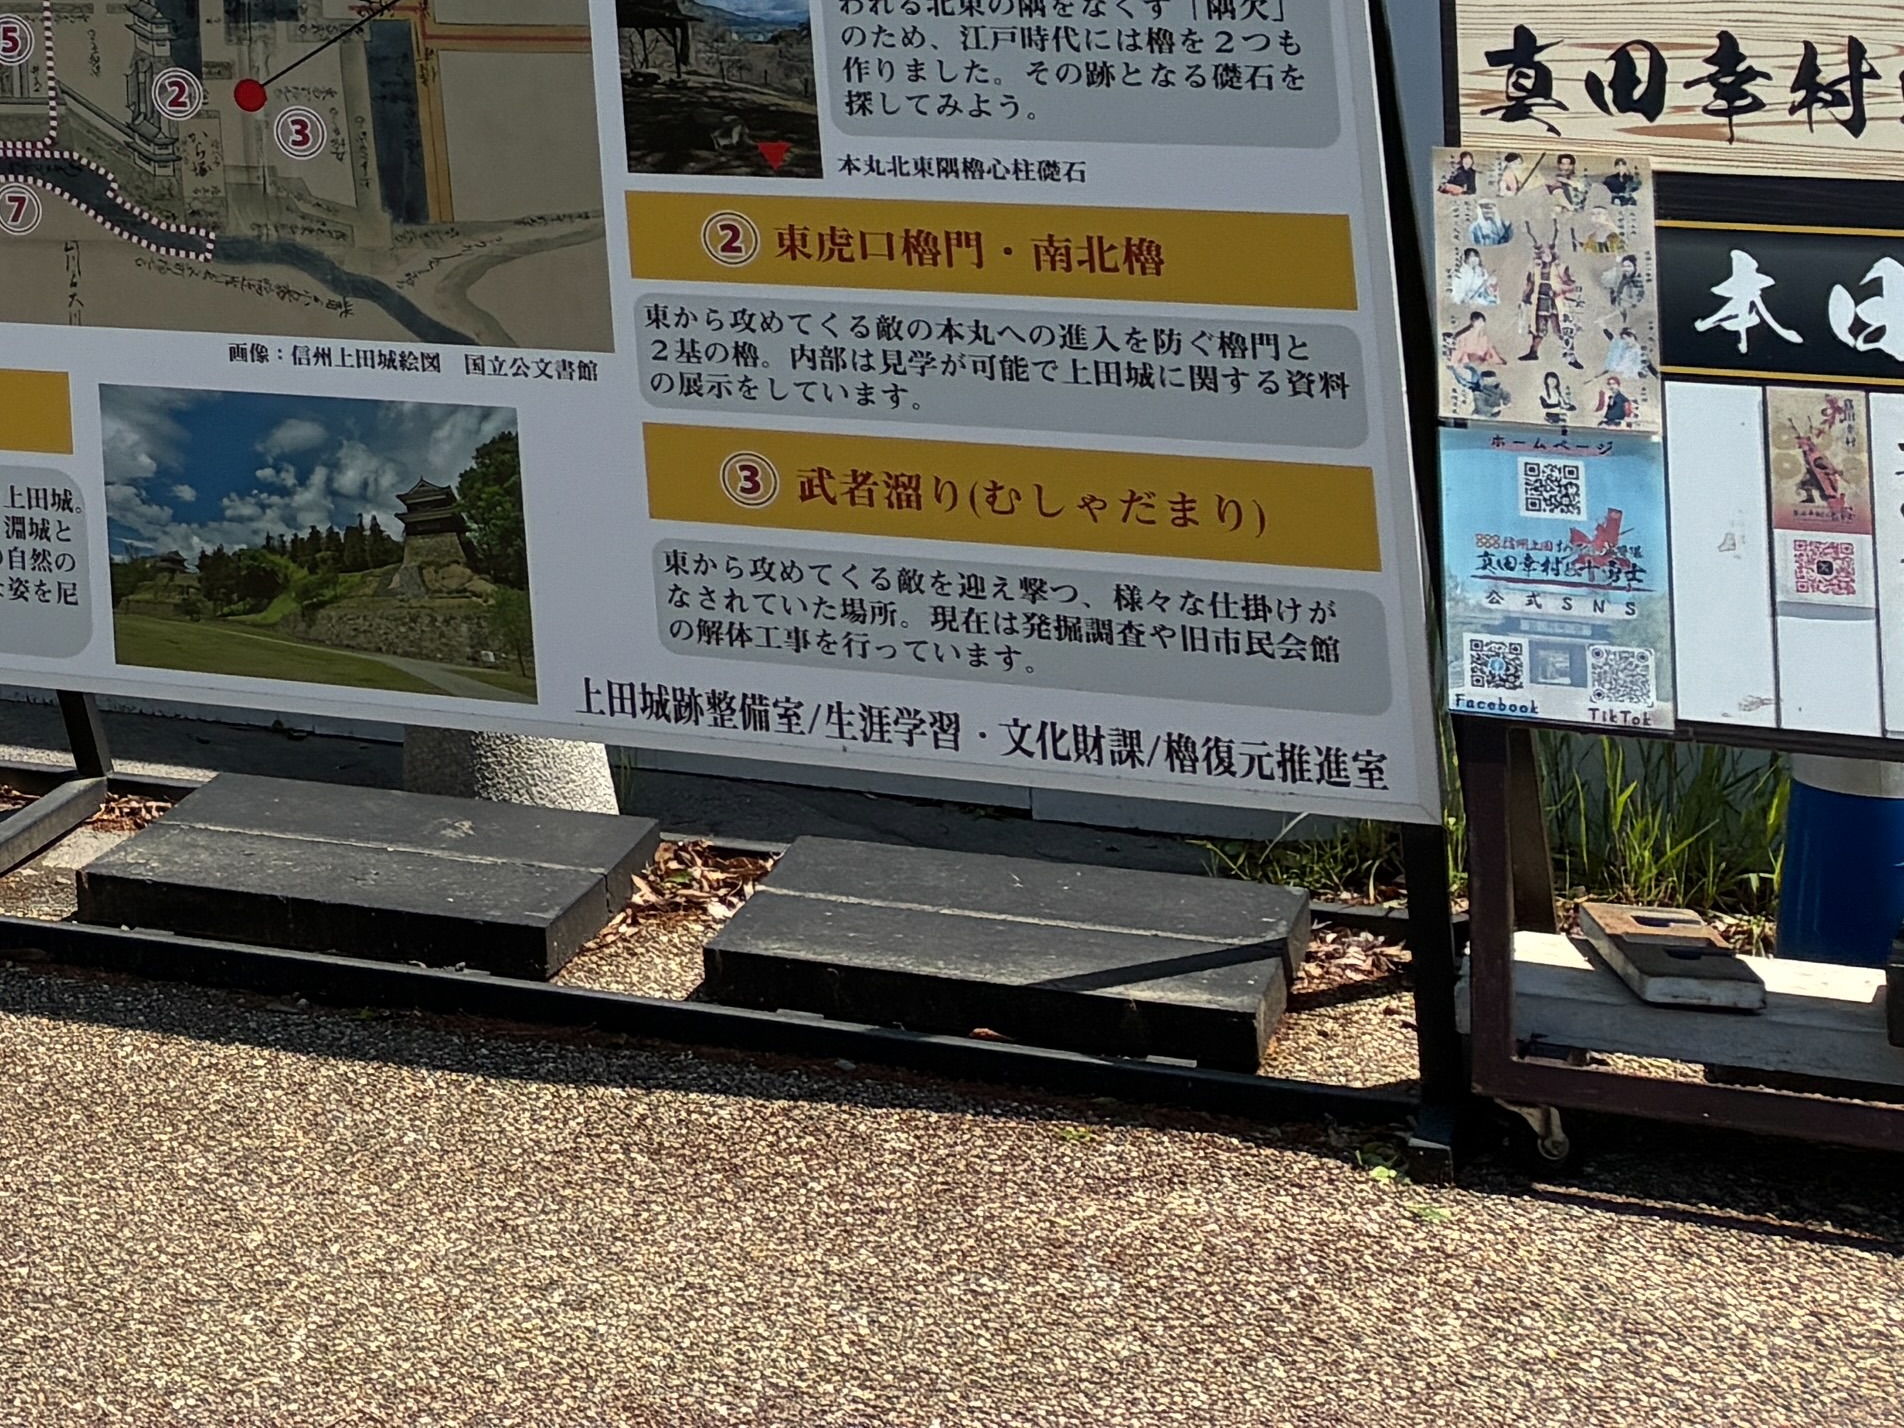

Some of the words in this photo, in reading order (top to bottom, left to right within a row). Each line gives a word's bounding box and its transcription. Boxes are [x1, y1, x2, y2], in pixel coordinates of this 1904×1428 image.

[1481, 24, 1904, 144] 真田幸村
[845, 89, 1038, 122] 探してみよう。
[775, 224, 1165, 277] 東虎口櫓門・南北櫓
[645, 304, 1308, 362] 東から攻めてくる敵の本丸への進入を防ぐ櫓門と
[464, 354, 598, 382] 国立公文書館
[651, 371, 921, 411] の展示をしています。
[1492, 434, 1613, 455] ホームページ
[668, 583, 1340, 663] なされていた場所。現在は発掘調査や旧市民会館
[670, 618, 1035, 675] の解体工事を行っています。
[1455, 693, 1539, 715] Facebook
[1588, 708, 1652, 727] TikTok
